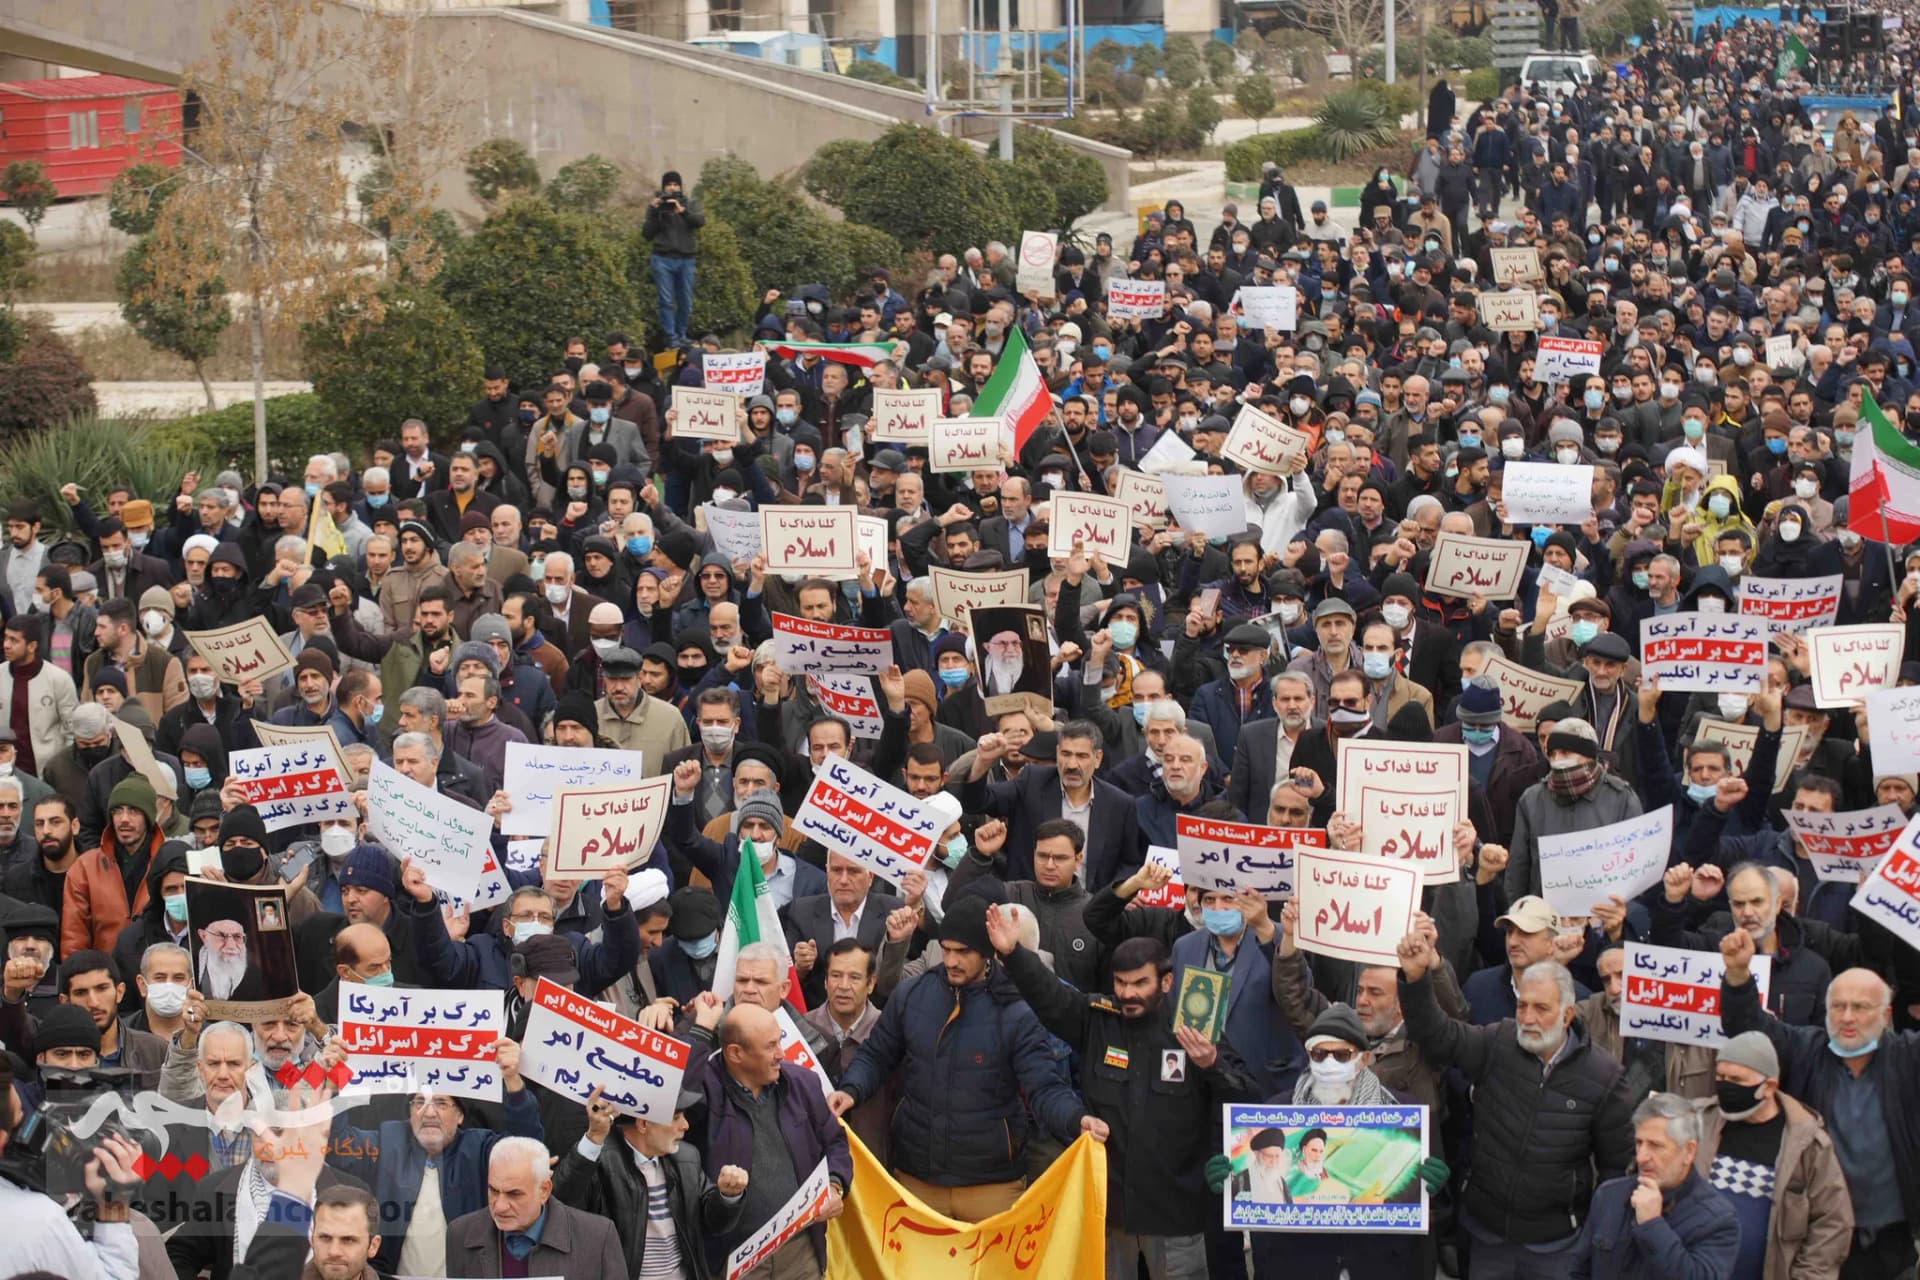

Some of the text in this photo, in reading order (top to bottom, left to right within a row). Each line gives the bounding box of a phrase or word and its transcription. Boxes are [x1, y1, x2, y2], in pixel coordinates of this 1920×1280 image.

[1494, 310, 1524, 326] اسلام
[1544, 354, 1594, 367] مطیع امر
[689, 410, 724, 428] اسلام
[888, 413, 925, 433] اسلام
[947, 443, 986, 464] اسلام
[1240, 439, 1283, 464] اسلام
[1070, 503, 1117, 518] کلنا فداک یا
[779, 518, 836, 529] کلنا فداک یا
[1072, 523, 1115, 545] اسلام
[785, 538, 835, 561] اسلام
[1455, 548, 1508, 561] کلنا فداک یا
[949, 582, 1007, 592] کلنا فداک یا
[1450, 566, 1501, 587] اسلام
[1747, 584, 1834, 600] مرگ بر آمریکا
[1743, 600, 1836, 619] مرگ بر اسرائیل
[779, 621, 884, 640] ما تا آخر ایستاده ایم
[1650, 618, 1758, 639] مرگ بر آمریکا
[204, 633, 252, 650] کلنا فداک یا
[789, 640, 881, 658] مطیع امر
[1646, 641, 1762, 662] مرگ بر اسرائیل
[1834, 639, 1890, 653] کلنا فداک یا
[222, 649, 265, 674] اسلام
[1500, 672, 1559, 698] کلنا فداک یا
[1707, 667, 1760, 683] مرگ بر
[1840, 661, 1888, 694] اسلام
[830, 680, 866, 696] مرگ بر
[837, 699, 846, 712] بر
[847, 700, 876, 716] مرگ
[853, 721, 881, 734] مرگ
[235, 753, 326, 776] مرگ بر آمریکا
[1364, 758, 1438, 774] کلنا فداک یا
[291, 775, 341, 792] مرگ بر
[829, 764, 935, 830] مرگ بر آمریکا
[303, 801, 347, 816] مرگ بر
[582, 796, 650, 820] کلنا فداک یا
[1380, 800, 1447, 816] کلنا فداک یا
[803, 817, 857, 846] انگلیس
[813, 790, 927, 857] مرگ بر اسرائیل
[1185, 823, 1316, 845] ما آخر ایستاده ایم
[1793, 815, 1896, 836] مرگ بر آمریکا
[581, 825, 645, 865] اسلام
[855, 846, 872, 858] بر
[1380, 830, 1444, 859] اسلام
[1807, 834, 1872, 857] بر اسرائیل
[1197, 847, 1230, 865] امر
[1601, 847, 1636, 872] قرآن
[1312, 868, 1391, 890] کلنا فداک یا
[1544, 875, 1573, 889] است
[1315, 898, 1382, 936] اسلام
[1634, 952, 1712, 984] بر آمریکا
[1629, 980, 1716, 1012] بر اسرائیل
[349, 993, 491, 1027] مرگ بر آمریکا
[544, 992, 679, 1060] ما تا آخر ایستاده ایم
[1629, 1013, 1711, 1038] بر انگلیس
[346, 1026, 497, 1059] مرگ بر اسرائیل
[543, 1028, 664, 1087] مطیع امر
[423, 1067, 440, 1086] بر
[446, 1065, 493, 1090] مرگ
[1288, 1111, 1305, 1126] دل
[1305, 1113, 1320, 1126] در
[1320, 1111, 1345, 1125] شهدا
[735, 1177, 823, 1263] مرگ بر آمریکا
